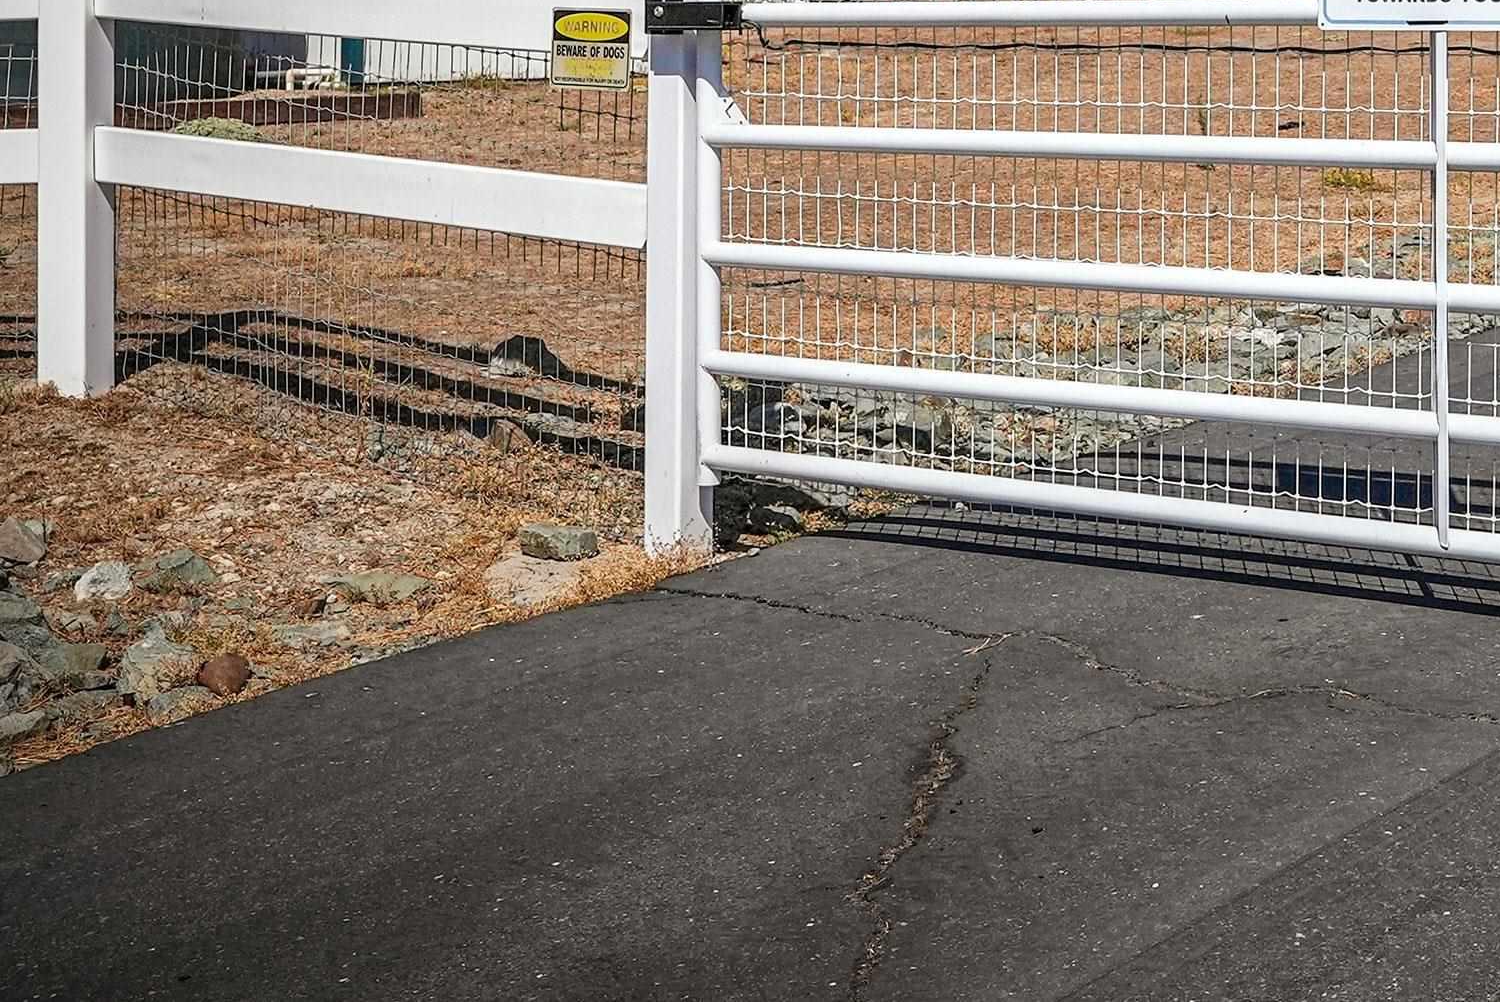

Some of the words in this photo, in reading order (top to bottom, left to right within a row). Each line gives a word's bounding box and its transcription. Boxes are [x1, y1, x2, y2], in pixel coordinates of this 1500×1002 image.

[564, 21, 620, 34] WARNING
[556, 44, 588, 57] BEWARE
[590, 46, 601, 58] OF
[603, 46, 625, 59] DOGS
